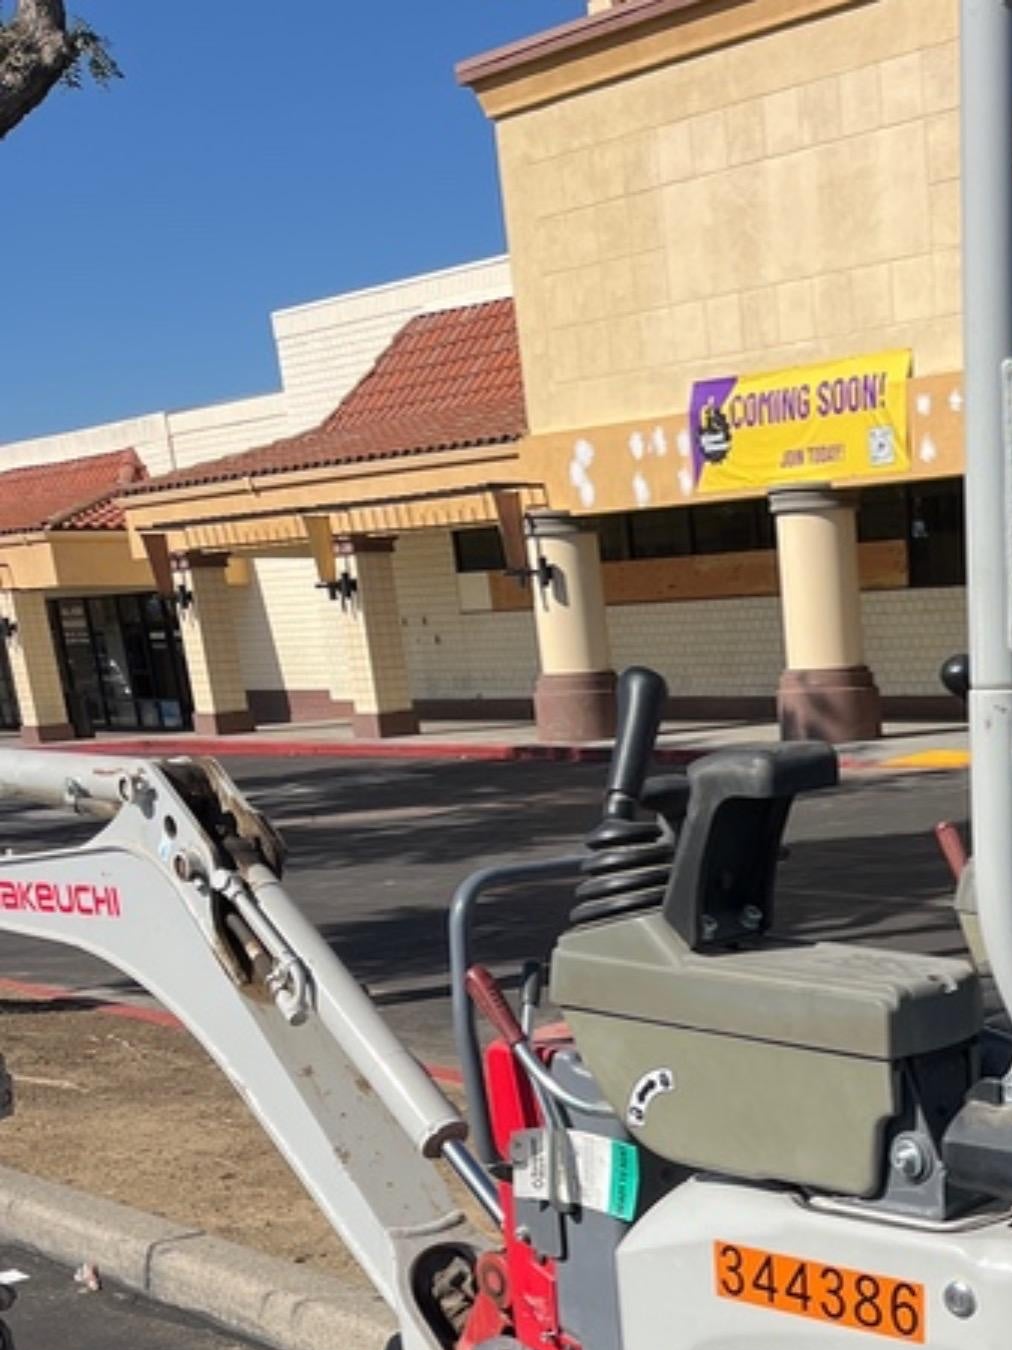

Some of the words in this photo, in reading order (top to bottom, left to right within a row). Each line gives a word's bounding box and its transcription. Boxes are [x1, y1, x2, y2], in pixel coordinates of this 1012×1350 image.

[729, 384, 810, 429] COMING
[816, 372, 887, 417] SOON!
[719, 1244, 920, 1336] 344386
